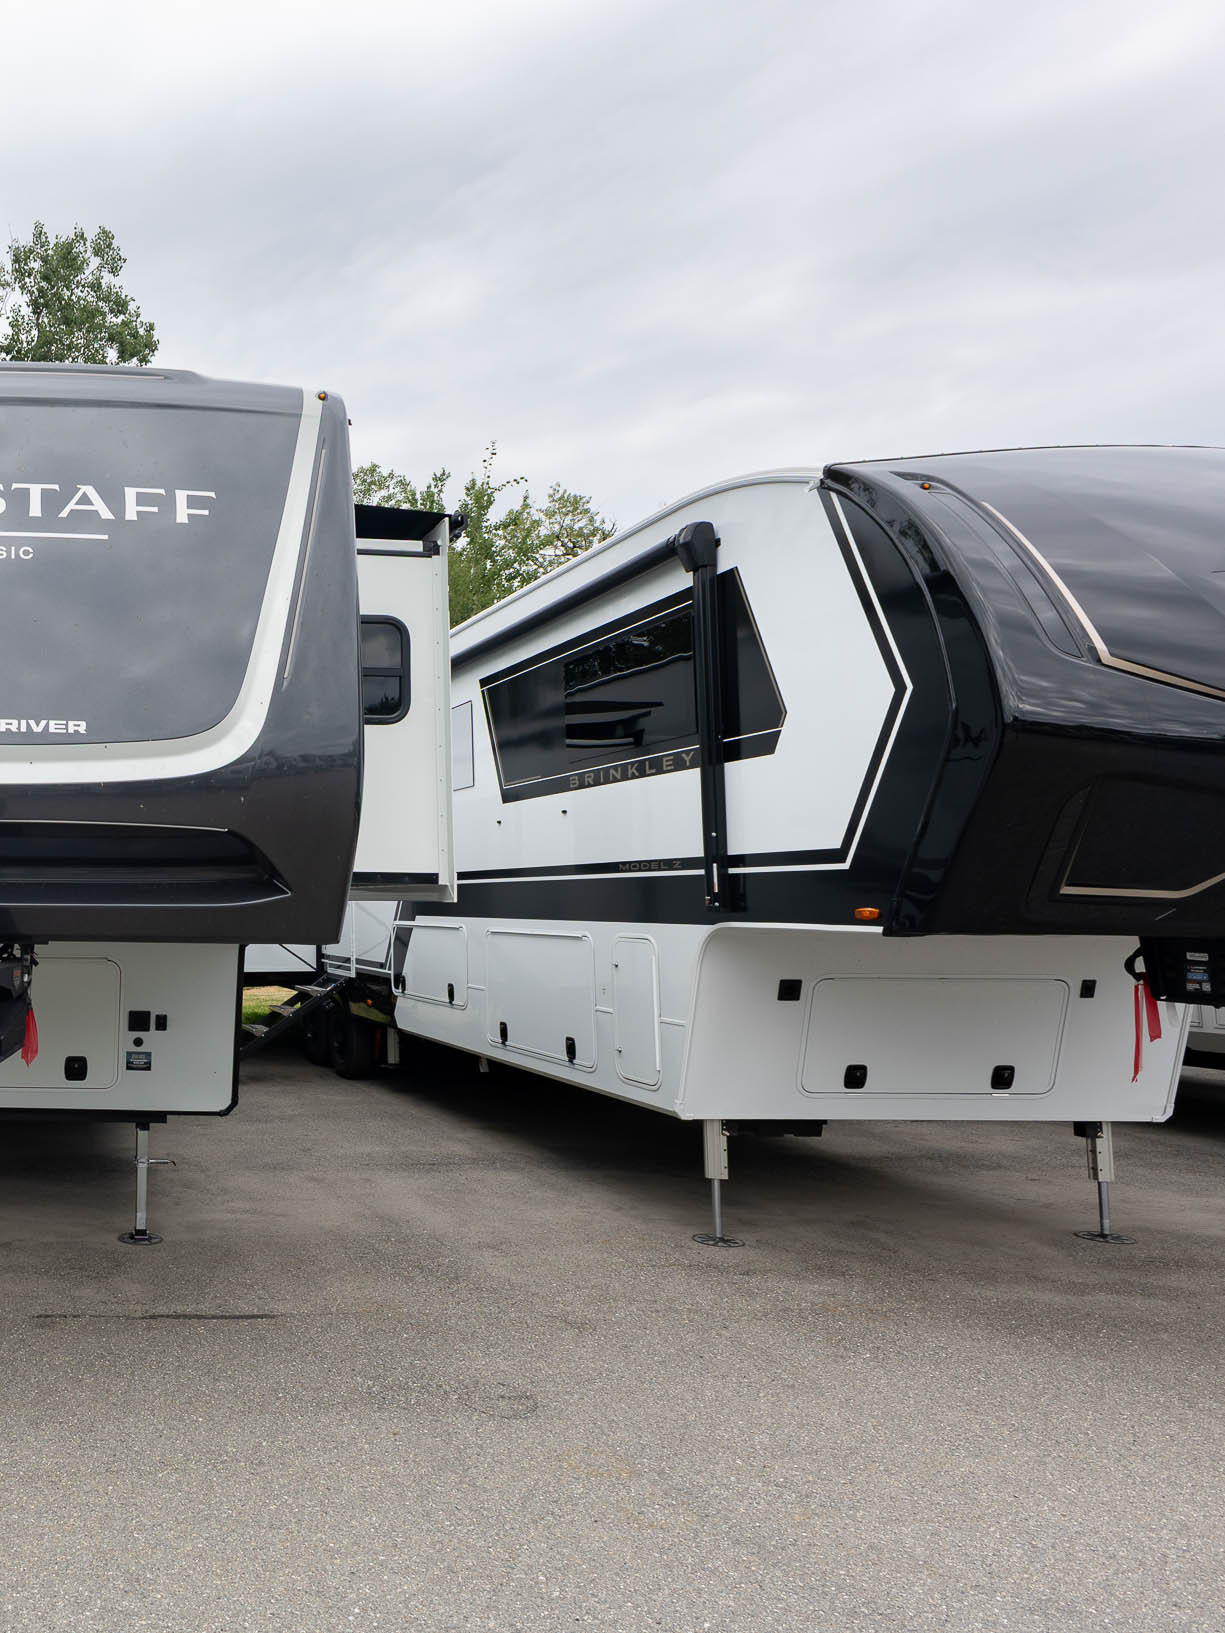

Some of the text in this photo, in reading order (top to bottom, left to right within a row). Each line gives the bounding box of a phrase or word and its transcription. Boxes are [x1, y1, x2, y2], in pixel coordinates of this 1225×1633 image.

[569, 752, 694, 788] BRINKLEY
[618, 860, 682, 872] MODEL Z
